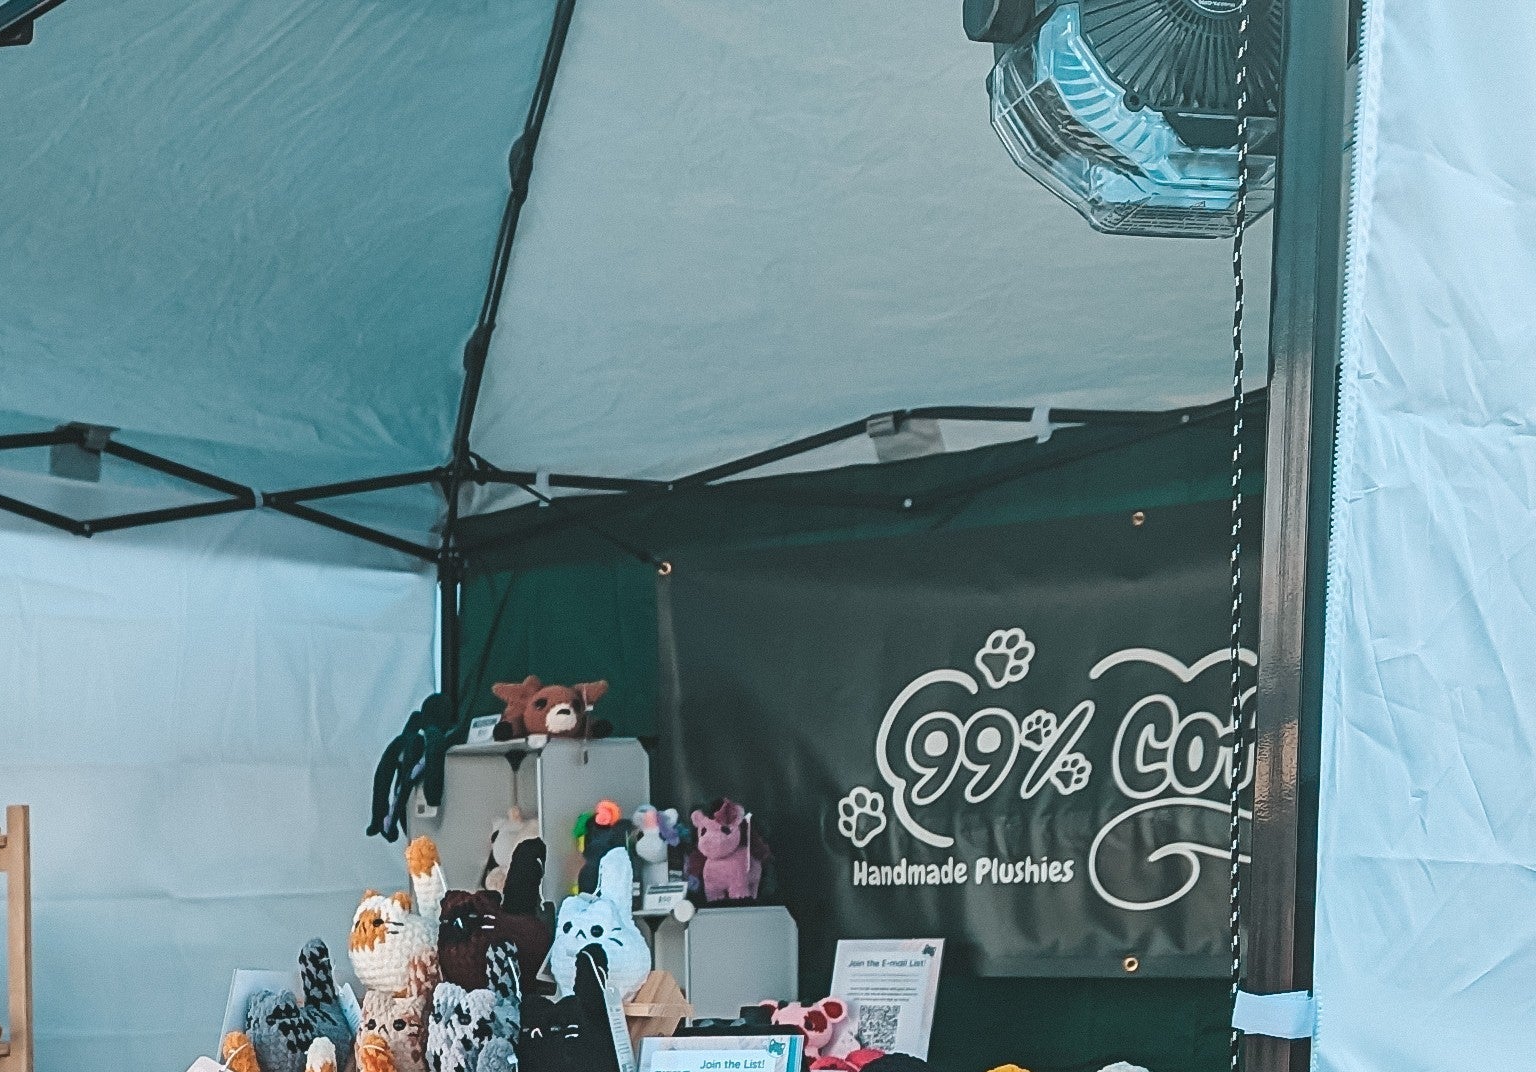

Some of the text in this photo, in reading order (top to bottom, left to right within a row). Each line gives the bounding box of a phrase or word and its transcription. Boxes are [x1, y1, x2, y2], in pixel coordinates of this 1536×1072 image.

[905, 700, 1096, 804] 99%
[853, 856, 1075, 887] Handmade Plushies
[848, 959, 864, 968] Join
[866, 959, 880, 968] the
[700, 1059, 765, 1070] Join the List!
